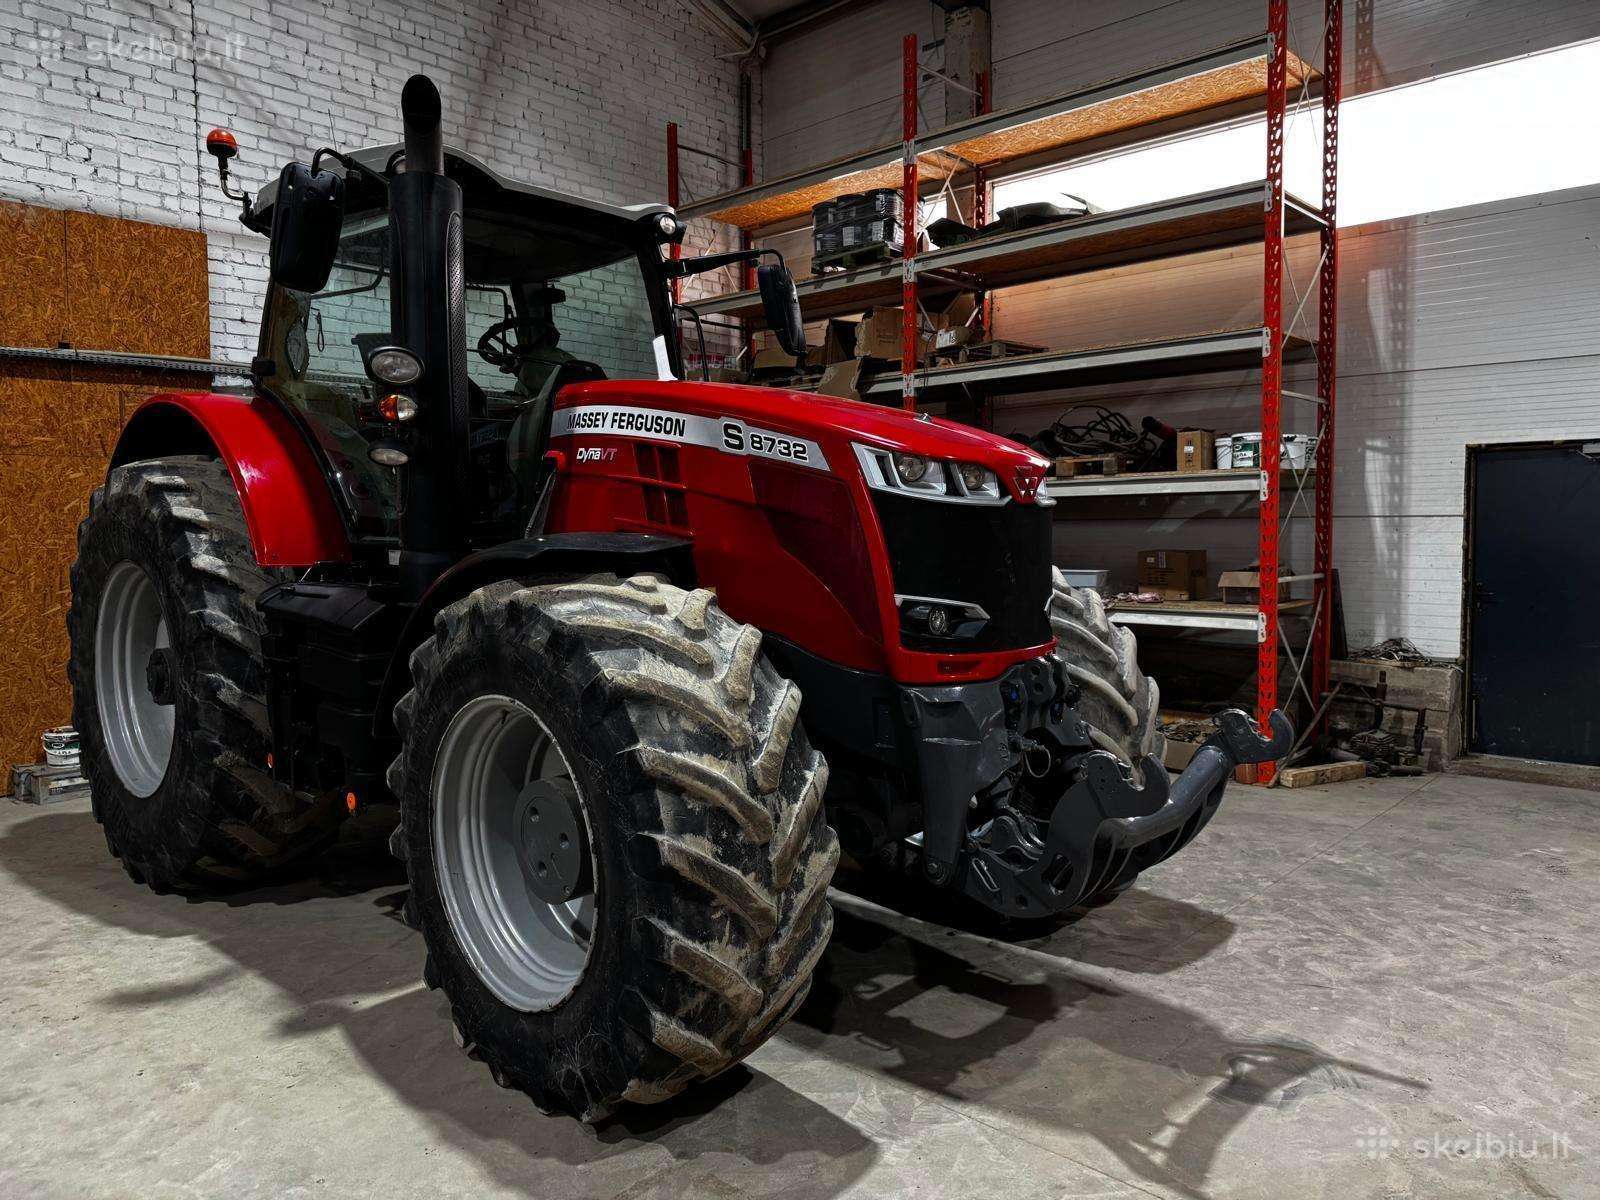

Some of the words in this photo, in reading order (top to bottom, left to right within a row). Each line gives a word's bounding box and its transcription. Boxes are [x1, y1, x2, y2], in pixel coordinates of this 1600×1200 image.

[567, 412, 608, 430] MASSEY
[610, 413, 687, 437] FERGUSON
[722, 421, 745, 452] S
[749, 433, 809, 462] 8732
